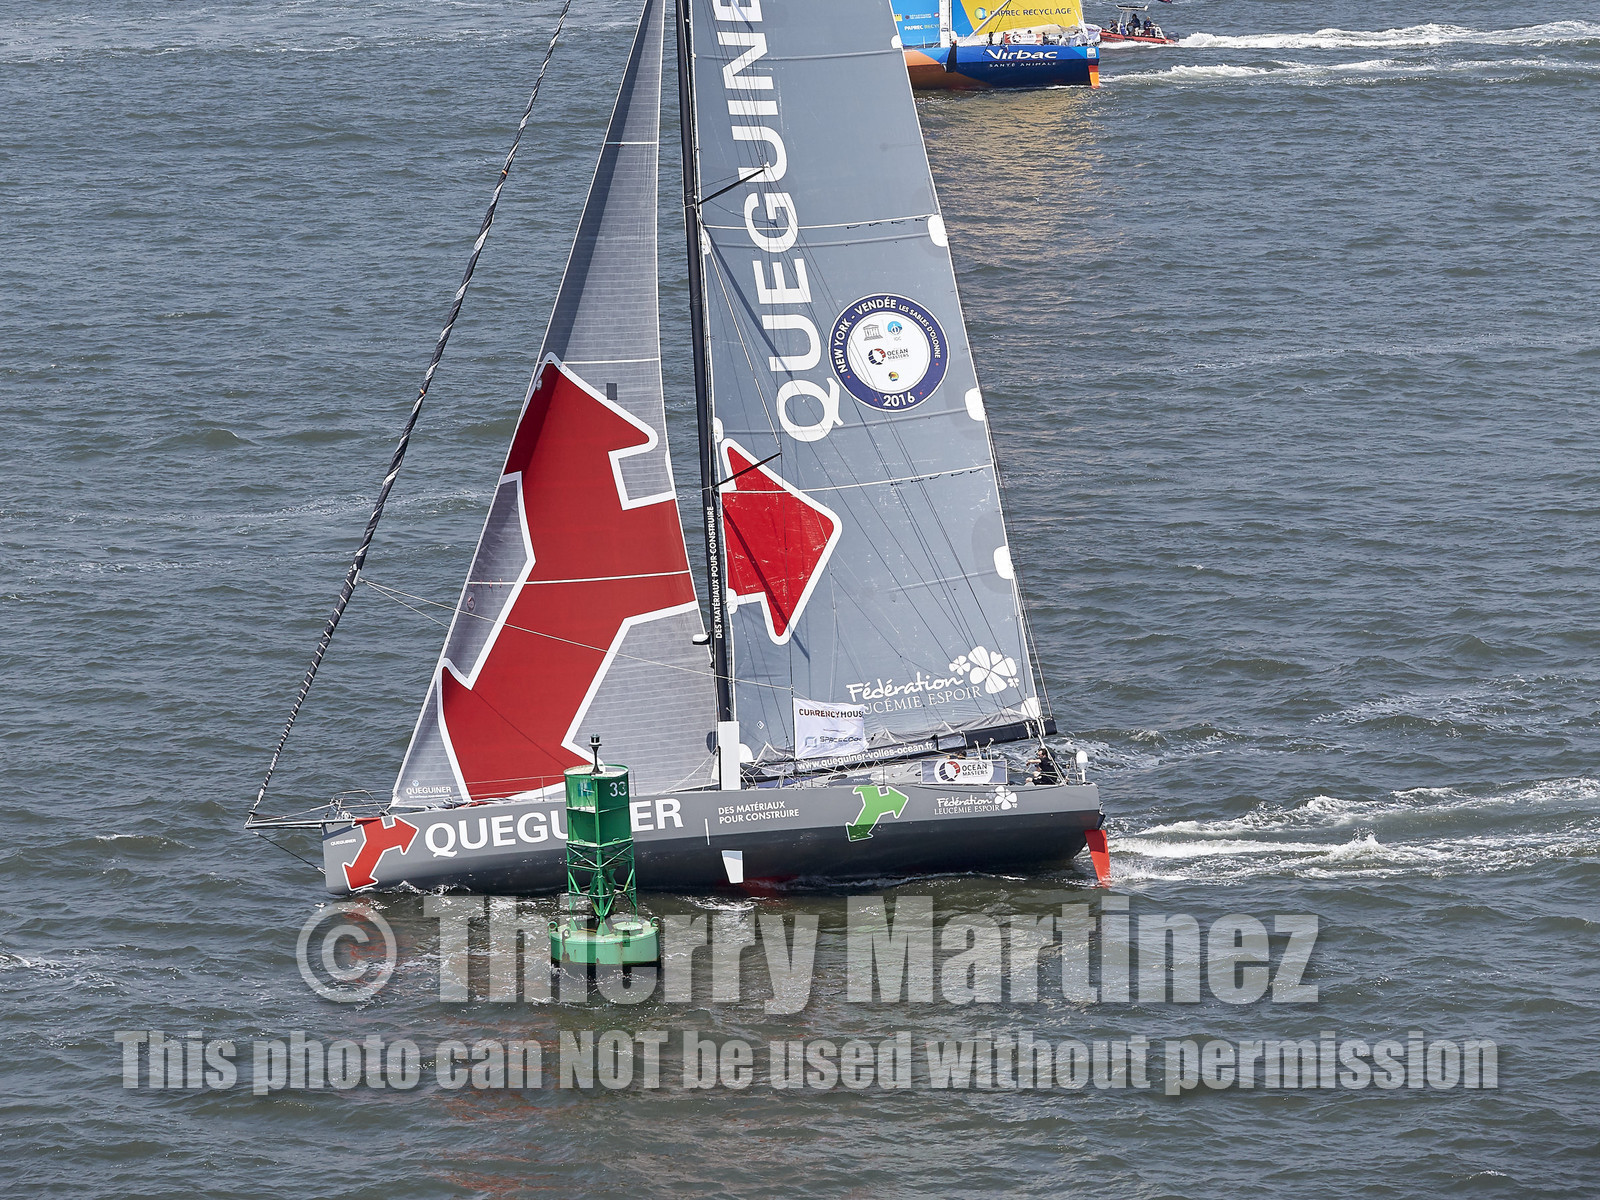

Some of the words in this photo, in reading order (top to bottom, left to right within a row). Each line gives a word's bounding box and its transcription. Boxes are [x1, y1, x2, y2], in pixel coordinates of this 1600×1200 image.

[1022, 7, 1072, 16] RECYCLAGE
[985, 49, 1058, 60] Virbac
[854, 296, 897, 316] VENDÉE
[898, 304, 910, 312] LES
[909, 309, 930, 328] SABLES
[833, 317, 852, 347] YORK
[887, 348, 909, 356] OCEAN
[833, 349, 849, 374] NEW
[882, 391, 916, 407] 2016
[706, 506, 717, 554] CONSTRUIRE
[710, 555, 719, 578] POUR
[711, 579, 722, 623] MATÉRIAUX
[715, 623, 723, 639] DES
[846, 671, 964, 703] Fédération
[863, 695, 923, 715] UCÉMIE
[928, 685, 983, 706] ESPOIR
[798, 708, 865, 719] CURRENCYHOUS
[961, 764, 988, 772] OCEAN
[406, 786, 452, 794] QUEGUINER
[609, 781, 627, 797] 33
[718, 806, 735, 816] DES
[736, 800, 786, 813] MATÉRIAUX
[936, 794, 993, 808] Fédération
[719, 814, 745, 825] POUR
[745, 808, 800, 822] CONSTRUIRE
[934, 806, 972, 816] LEUCÉMIE
[974, 804, 1000, 813] ESPOIR
[424, 798, 684, 858] QUEGUER
